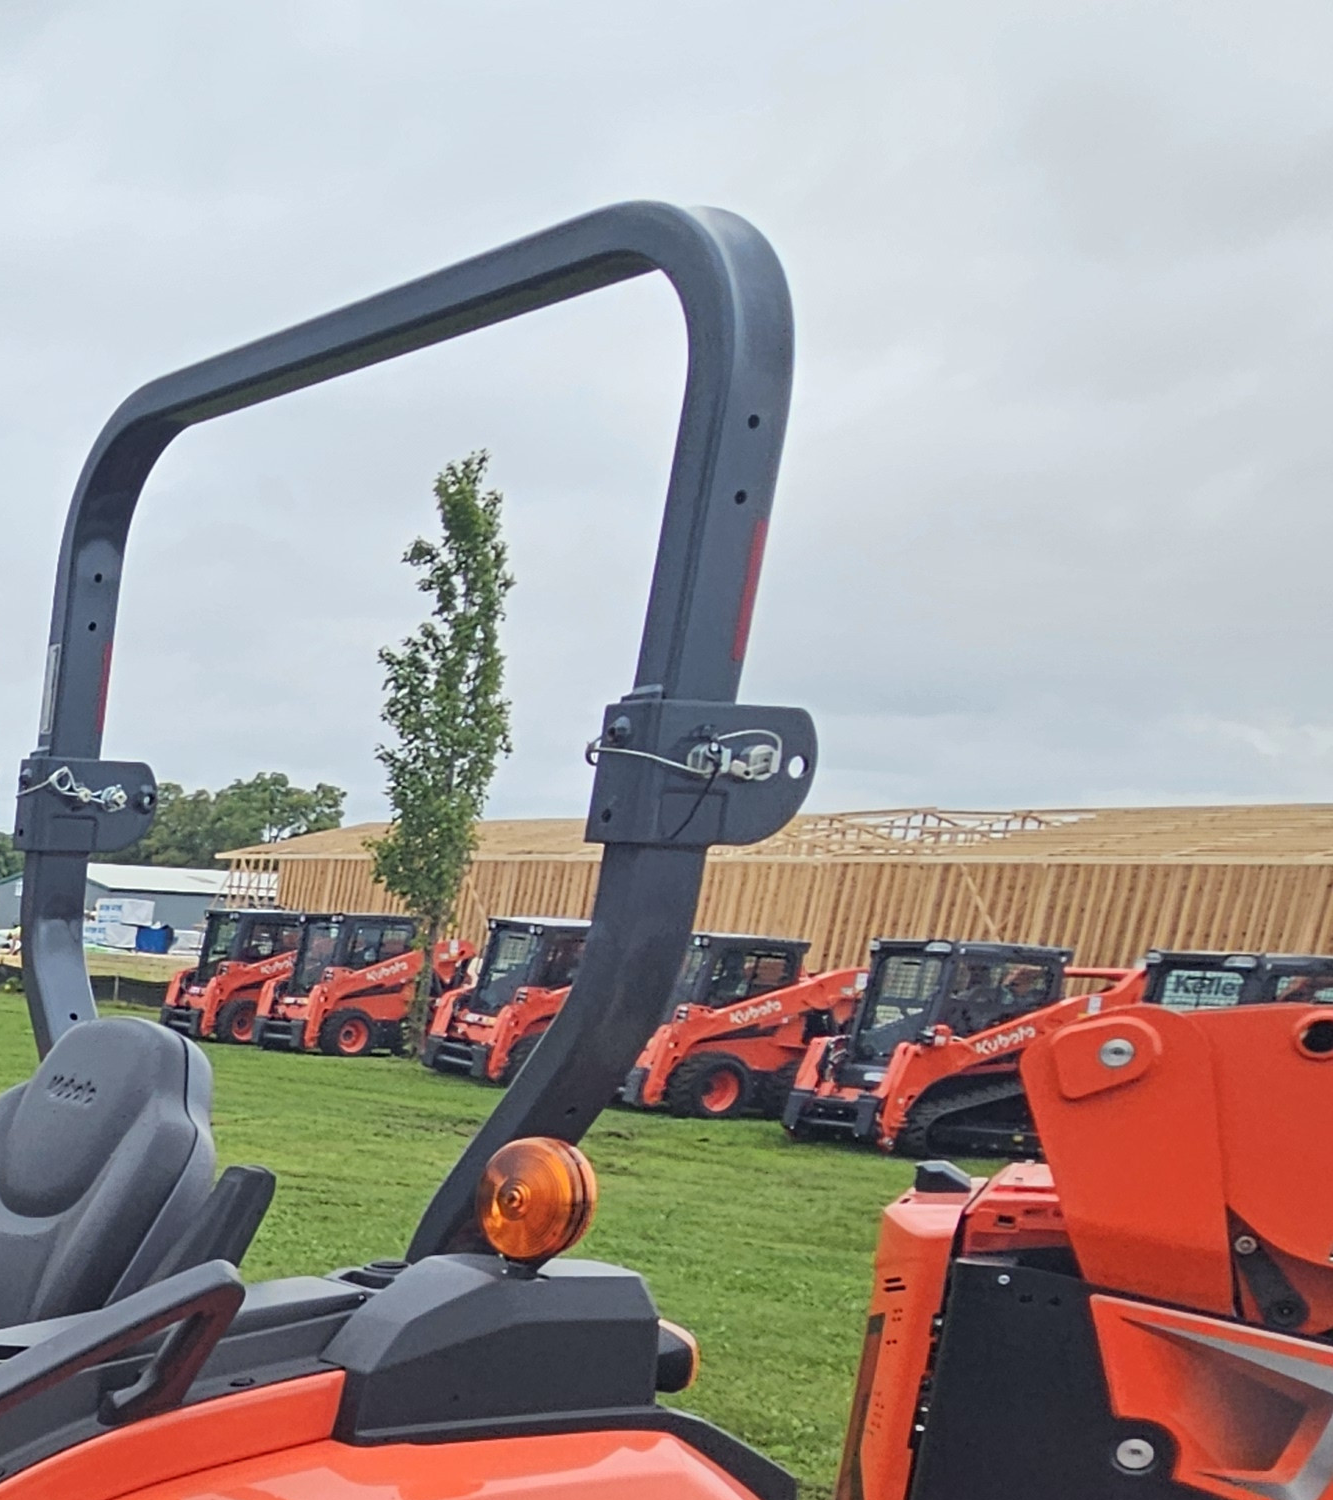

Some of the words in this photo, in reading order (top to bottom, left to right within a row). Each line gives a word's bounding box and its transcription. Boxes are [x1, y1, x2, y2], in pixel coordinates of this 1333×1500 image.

[365, 961, 409, 981] Kubota
[729, 1000, 783, 1025] Kubota
[975, 1026, 1036, 1055] Kubota
